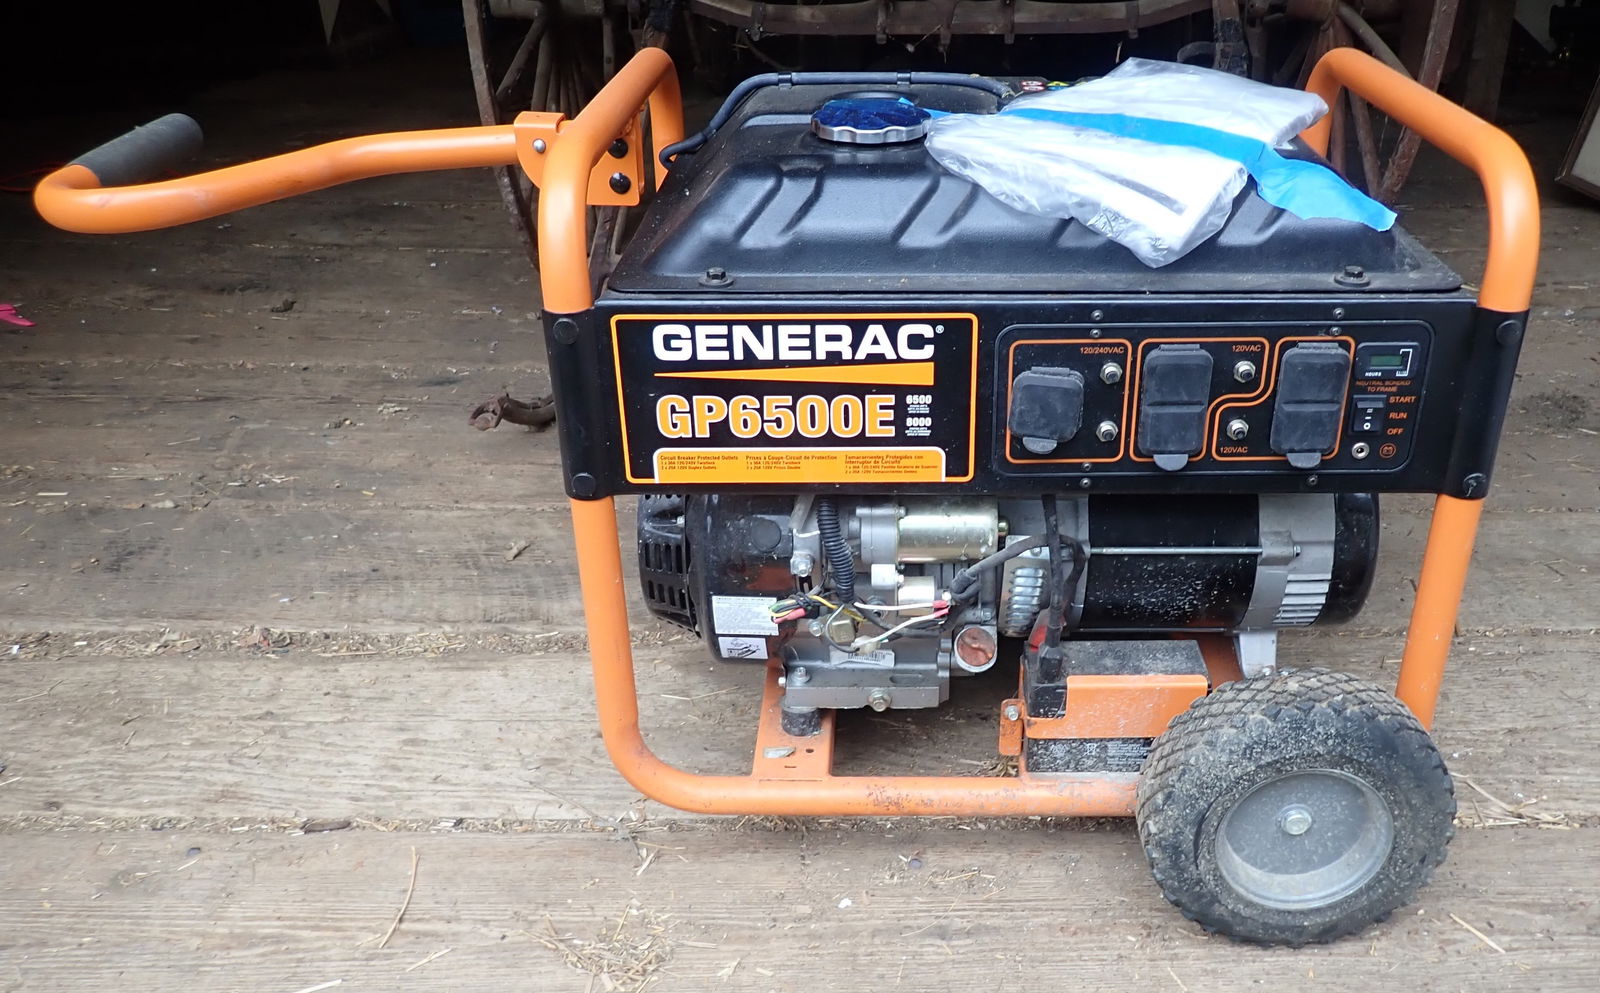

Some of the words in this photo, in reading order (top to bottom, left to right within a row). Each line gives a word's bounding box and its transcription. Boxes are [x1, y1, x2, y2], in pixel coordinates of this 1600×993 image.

[1080, 347, 1124, 355] 120/240VAC
[656, 394, 896, 438] GP6500E
[1220, 446, 1248, 454] 120VAC
